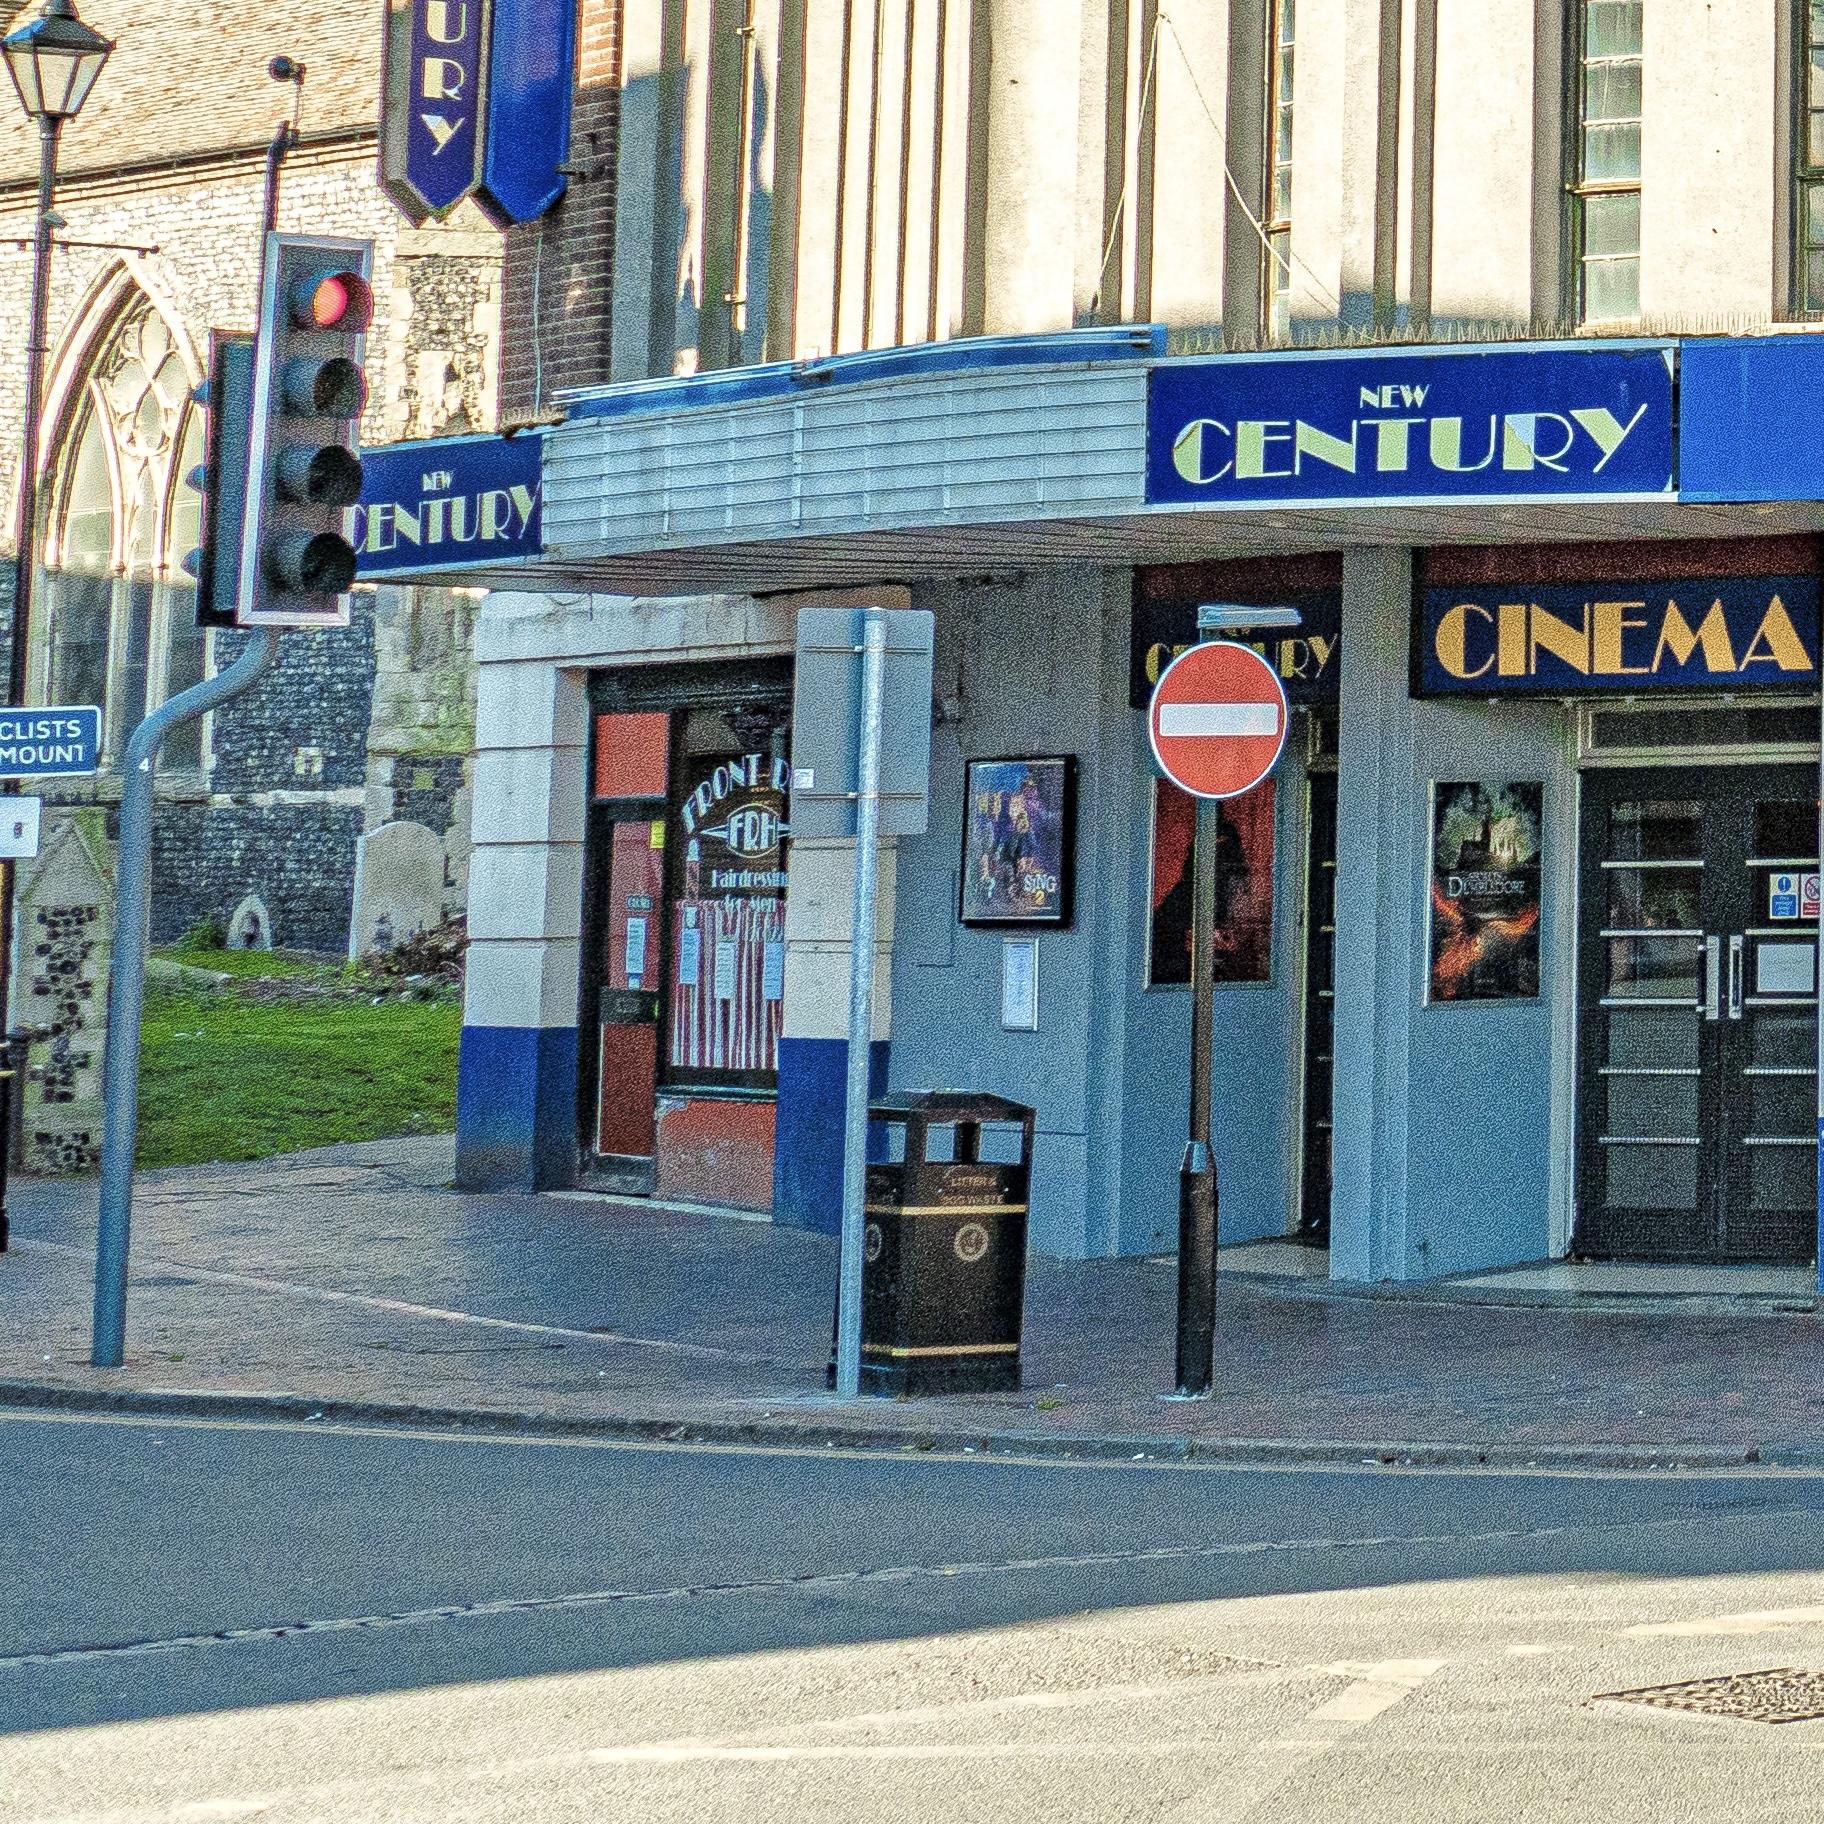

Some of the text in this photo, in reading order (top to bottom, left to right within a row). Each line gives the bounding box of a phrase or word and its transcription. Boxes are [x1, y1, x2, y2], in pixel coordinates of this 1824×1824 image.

[1359, 383, 1430, 409] NEW
[1173, 403, 1649, 484] CENTURY
[422, 469, 455, 492] NEW
[342, 480, 541, 555] CENTURY
[1434, 594, 1814, 678] CINEMA
[138, 758, 150, 772] 4
[729, 810, 778, 851] FRH
[1023, 873, 1058, 895] SING
[1033, 889, 1045, 906] 2
